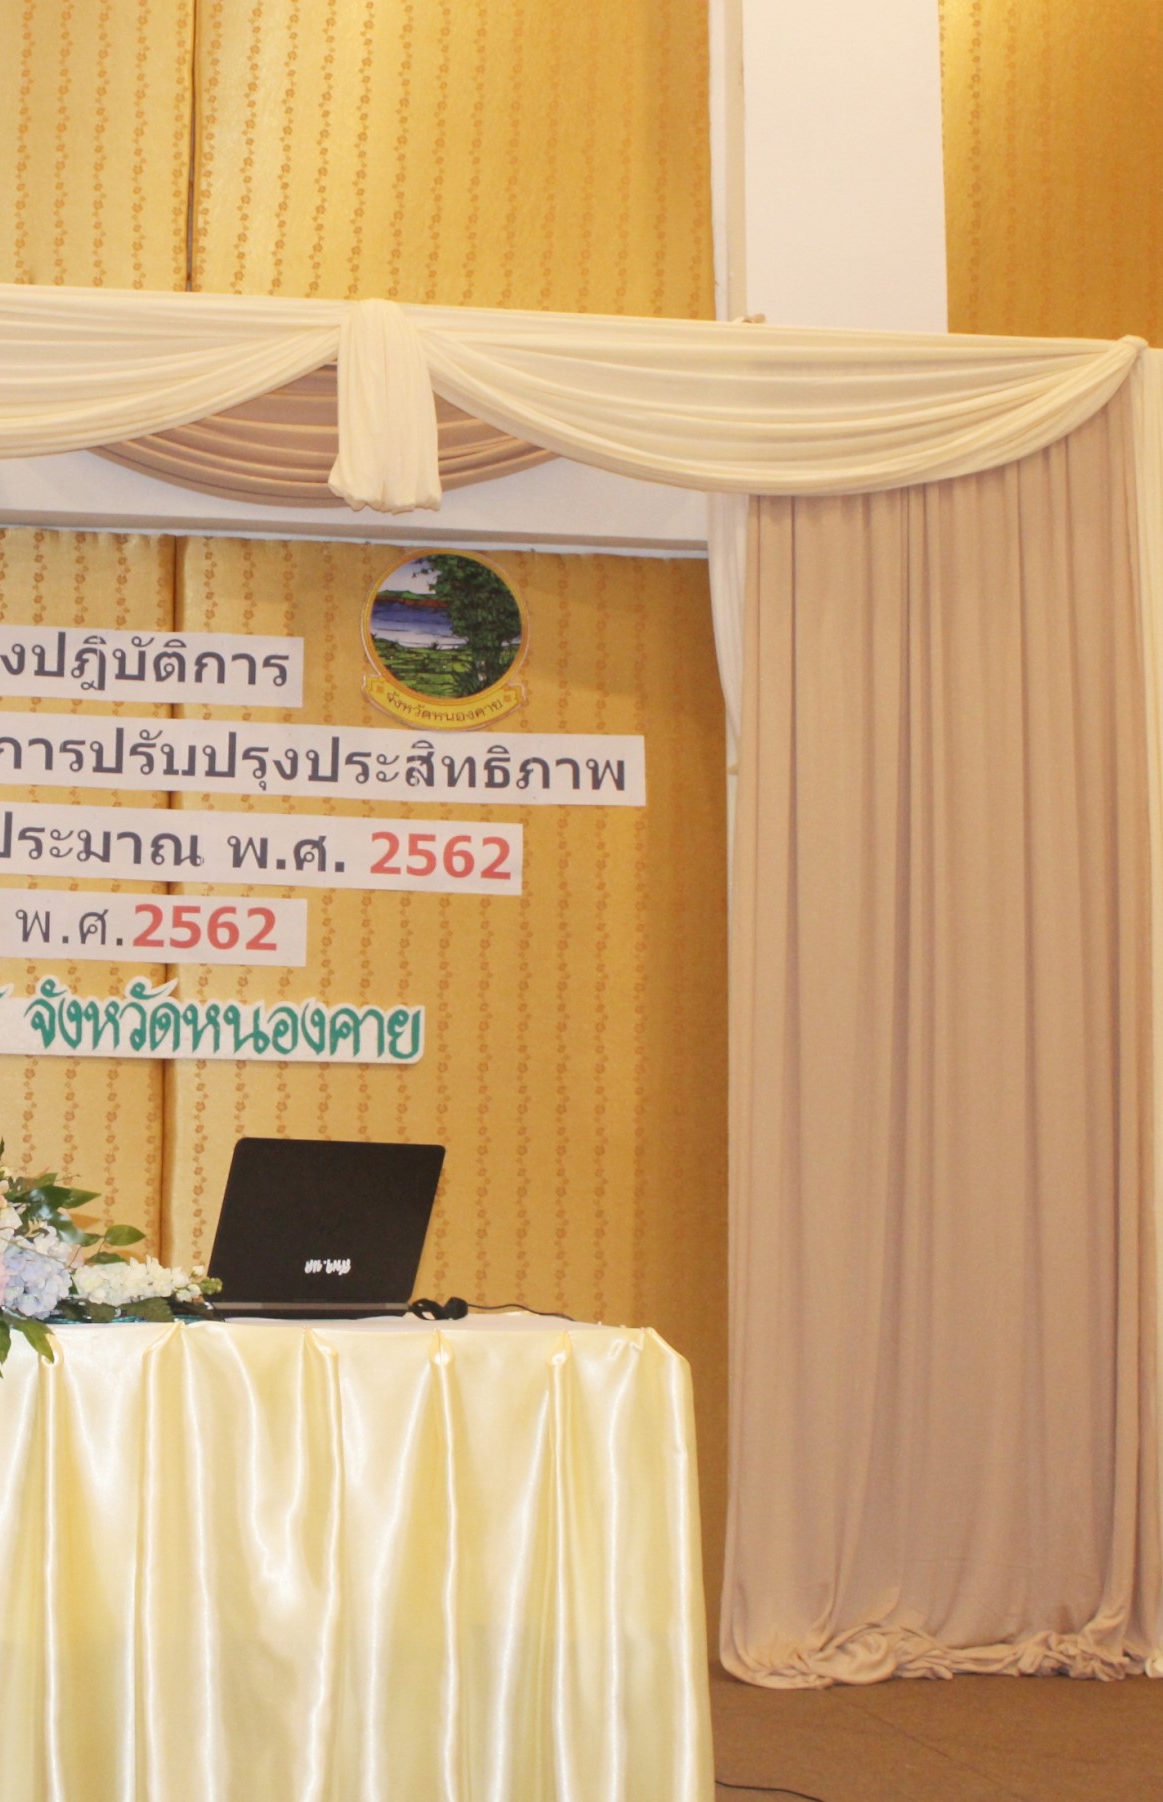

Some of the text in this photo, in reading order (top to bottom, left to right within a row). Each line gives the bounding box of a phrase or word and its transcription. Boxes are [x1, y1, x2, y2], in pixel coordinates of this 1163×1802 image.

[226, 834, 345, 873] พ.ศ.
[369, 831, 512, 881] 2562
[23, 978, 422, 1060] จังหวัดหนองคาย
